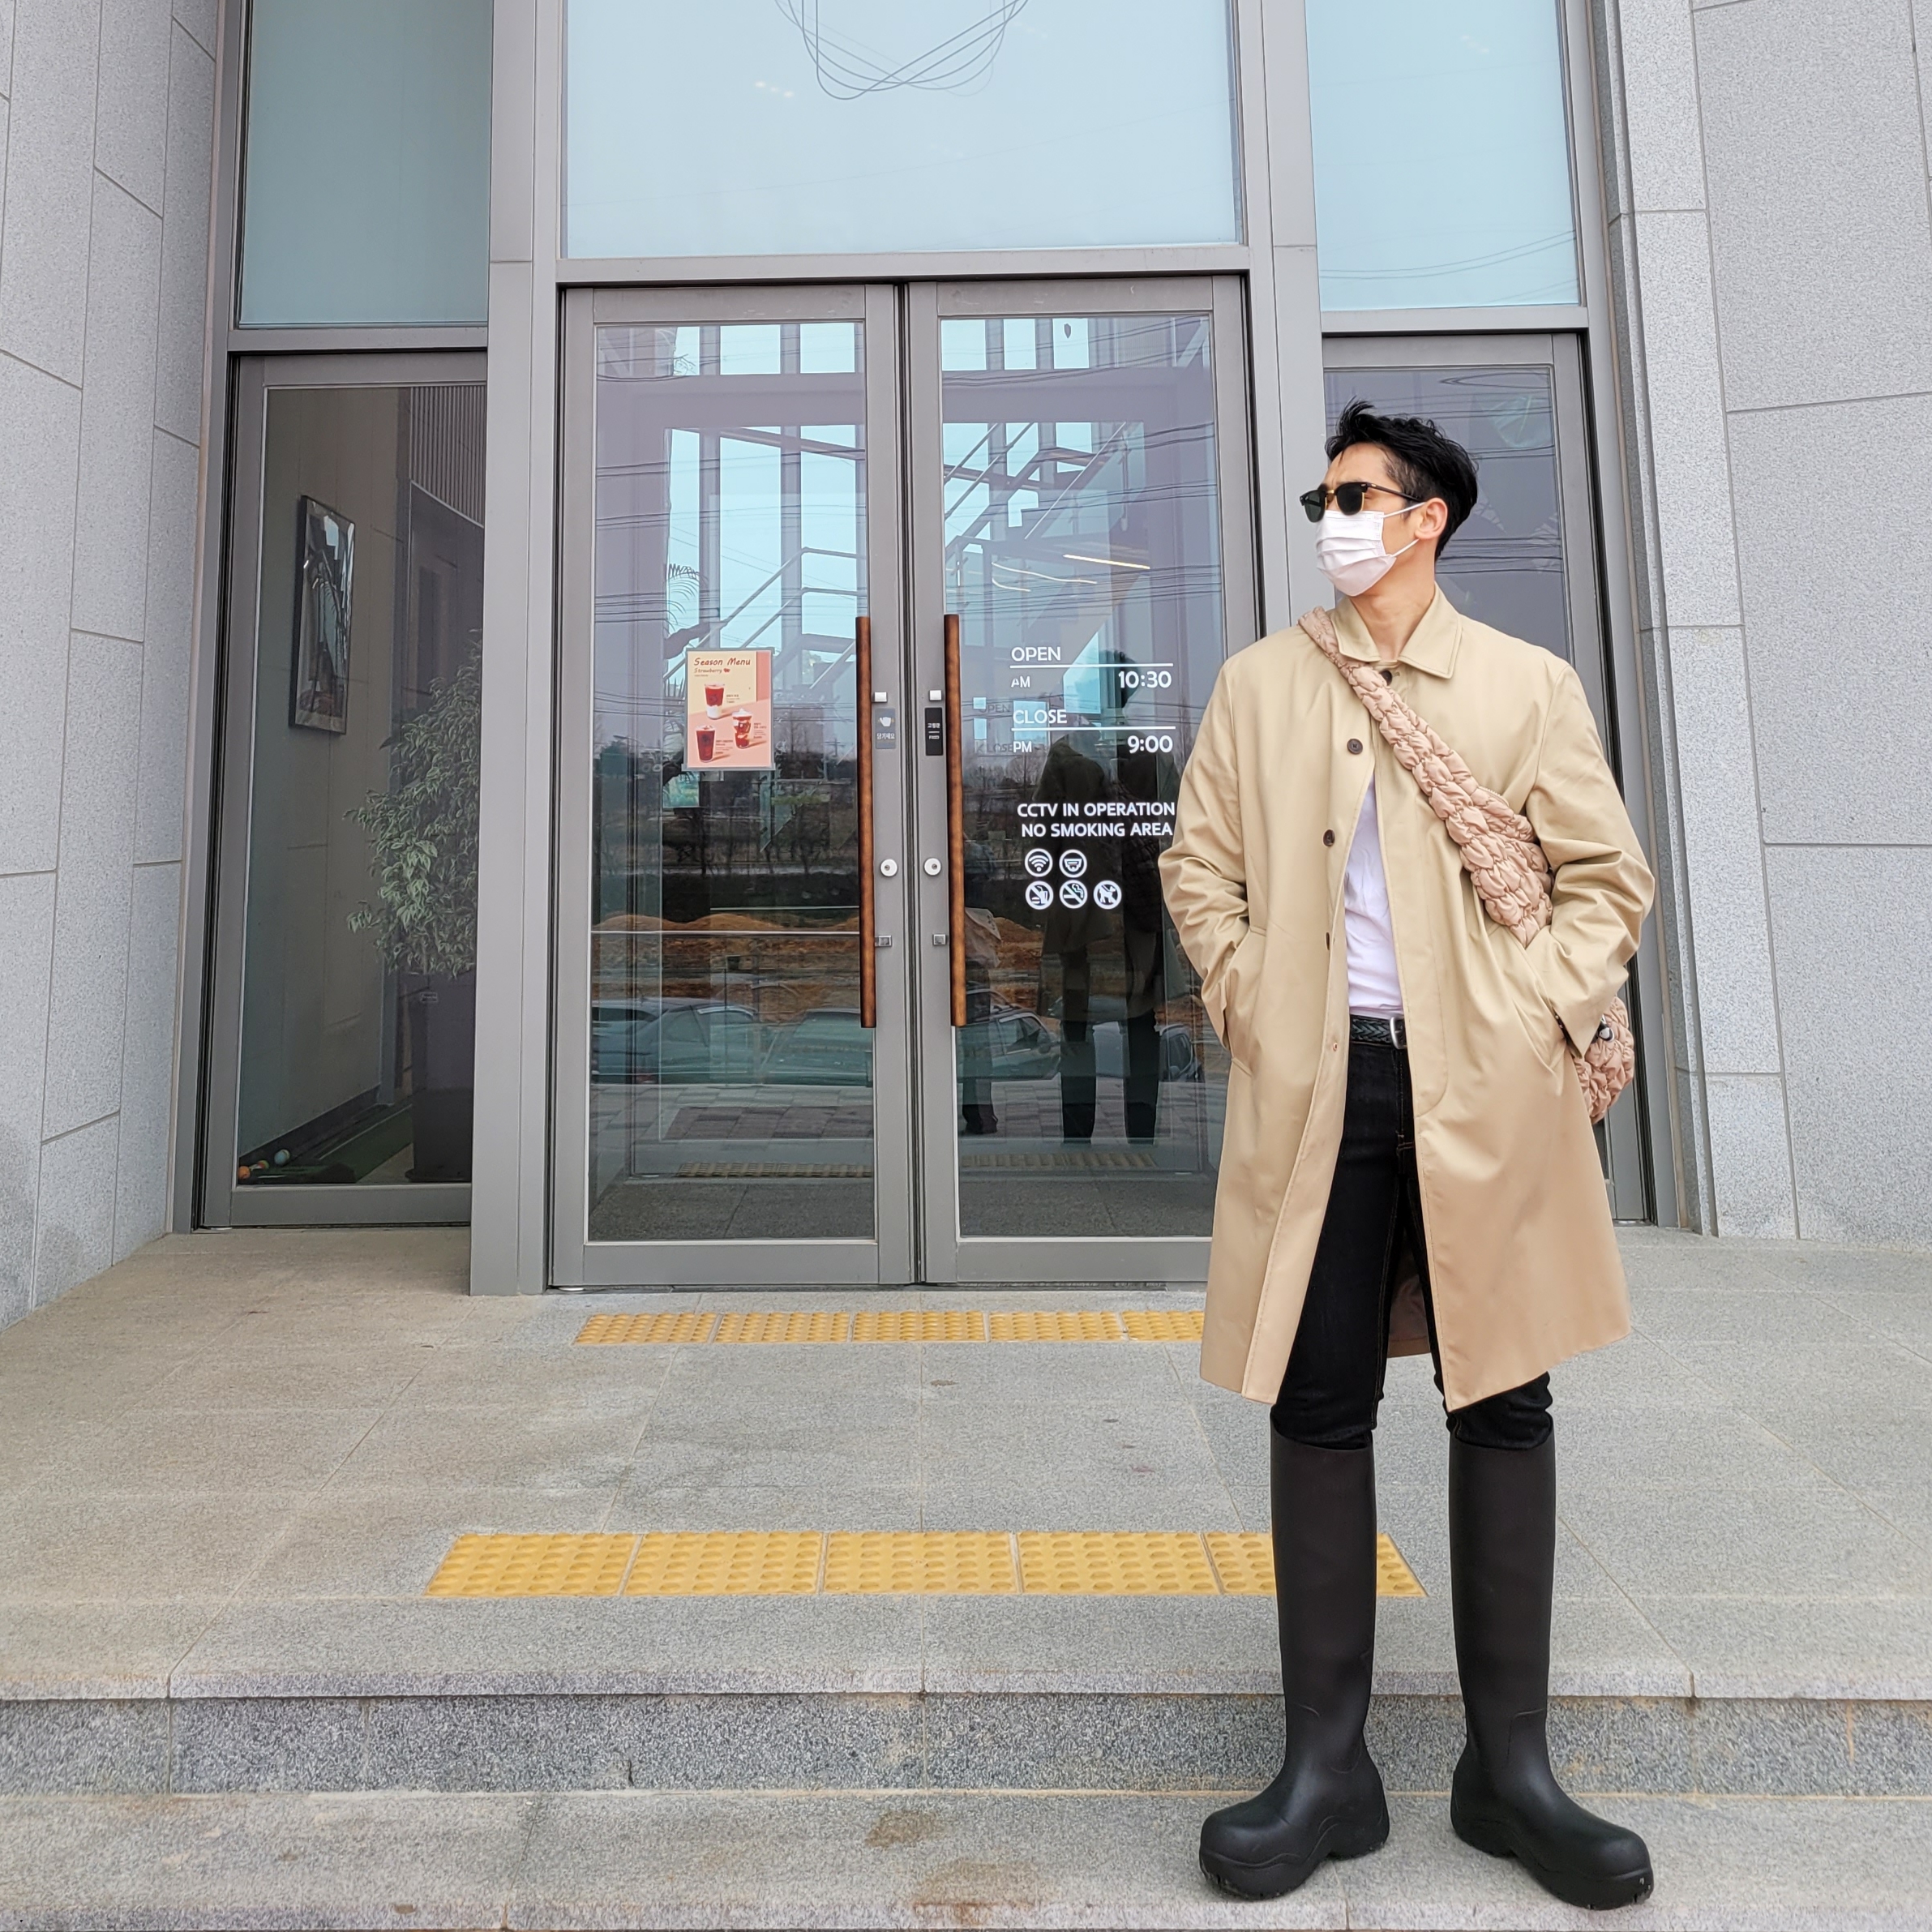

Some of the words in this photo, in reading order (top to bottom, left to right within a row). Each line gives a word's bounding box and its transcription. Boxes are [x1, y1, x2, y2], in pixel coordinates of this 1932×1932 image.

[693, 657, 723, 666] Season
[726, 657, 751, 666] Menu
[1011, 646, 1061, 662] OPEN
[1010, 676, 1030, 688] AM
[1118, 670, 1172, 688] 10:30
[1013, 709, 1068, 724] CLOSE
[1013, 740, 1032, 753] PM
[1127, 735, 1173, 755] 9:00
[1017, 803, 1058, 817] CCTV
[1062, 803, 1079, 817] IN
[1083, 802, 1176, 816] OPERATION
[1022, 824, 1047, 837] NO
[1051, 823, 1125, 837] SMOKING
[1129, 822, 1173, 837] AREA
